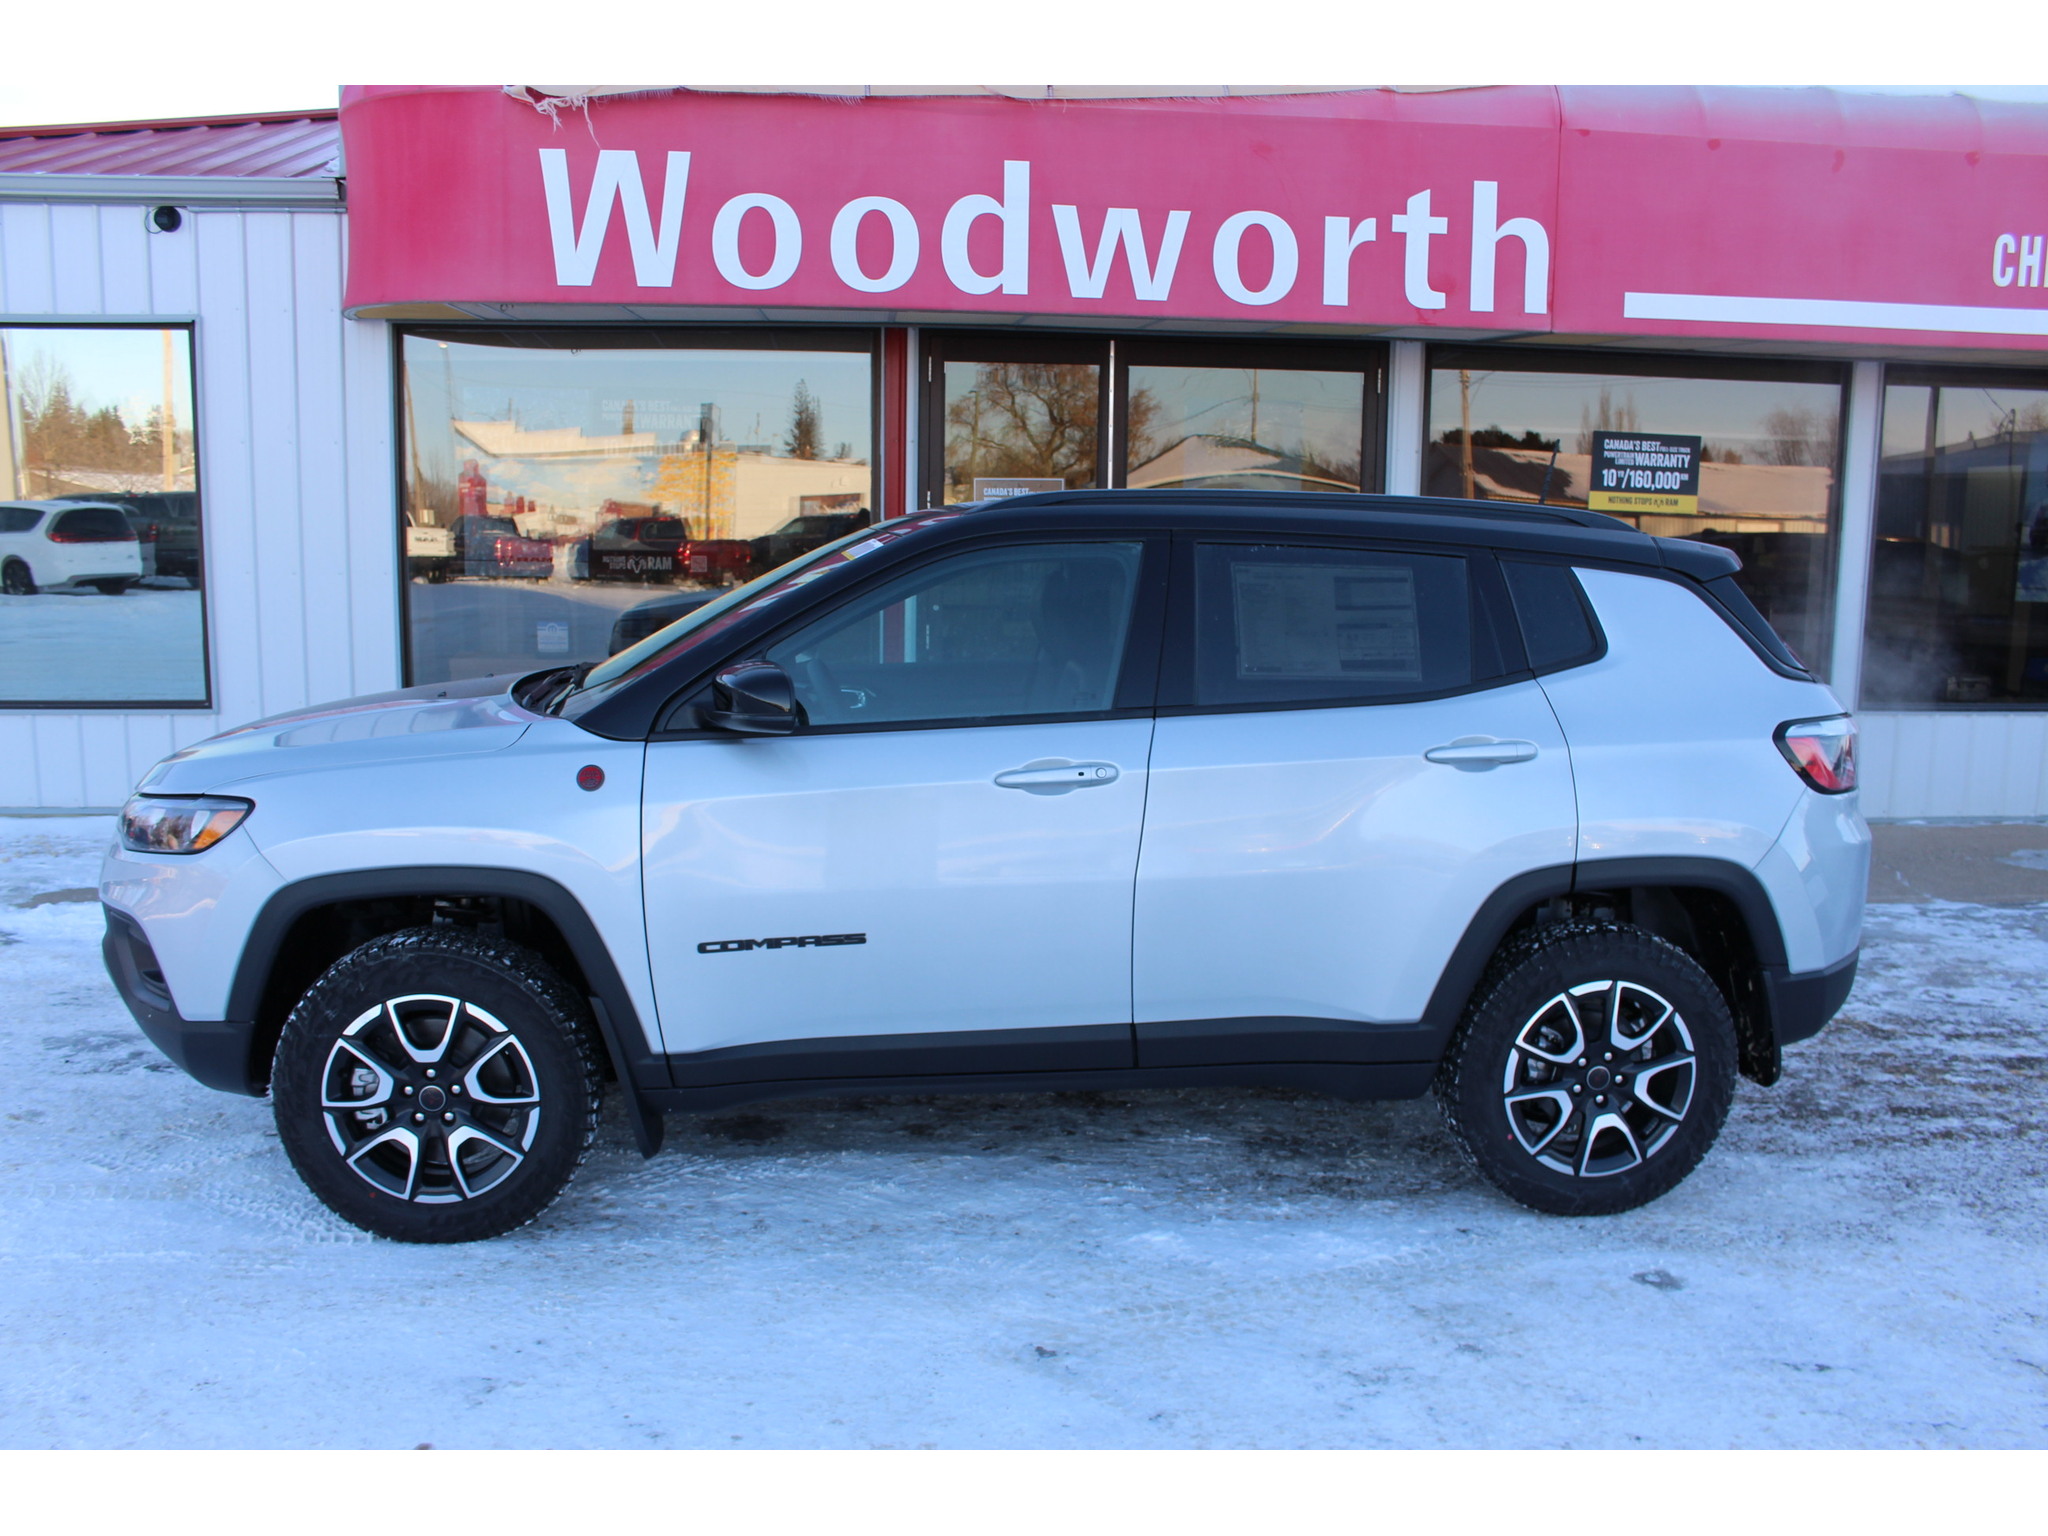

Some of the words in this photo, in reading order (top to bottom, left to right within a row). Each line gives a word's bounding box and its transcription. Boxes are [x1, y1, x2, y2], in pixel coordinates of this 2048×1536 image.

[539, 147, 1551, 315] Woodworth
[1603, 439, 1640, 451] CANADA'S
[1641, 441, 1661, 452] BEST
[1634, 453, 1691, 469] WARRANTY
[983, 487, 1013, 497] CANADA'S
[1013, 488, 1030, 497] BEST
[1608, 496, 1633, 505] NOTHING
[1633, 498, 1652, 506] STOPS
[1665, 499, 1679, 507] RAM
[647, 556, 673, 571] RAM
[697, 933, 867, 954] COMPASS
